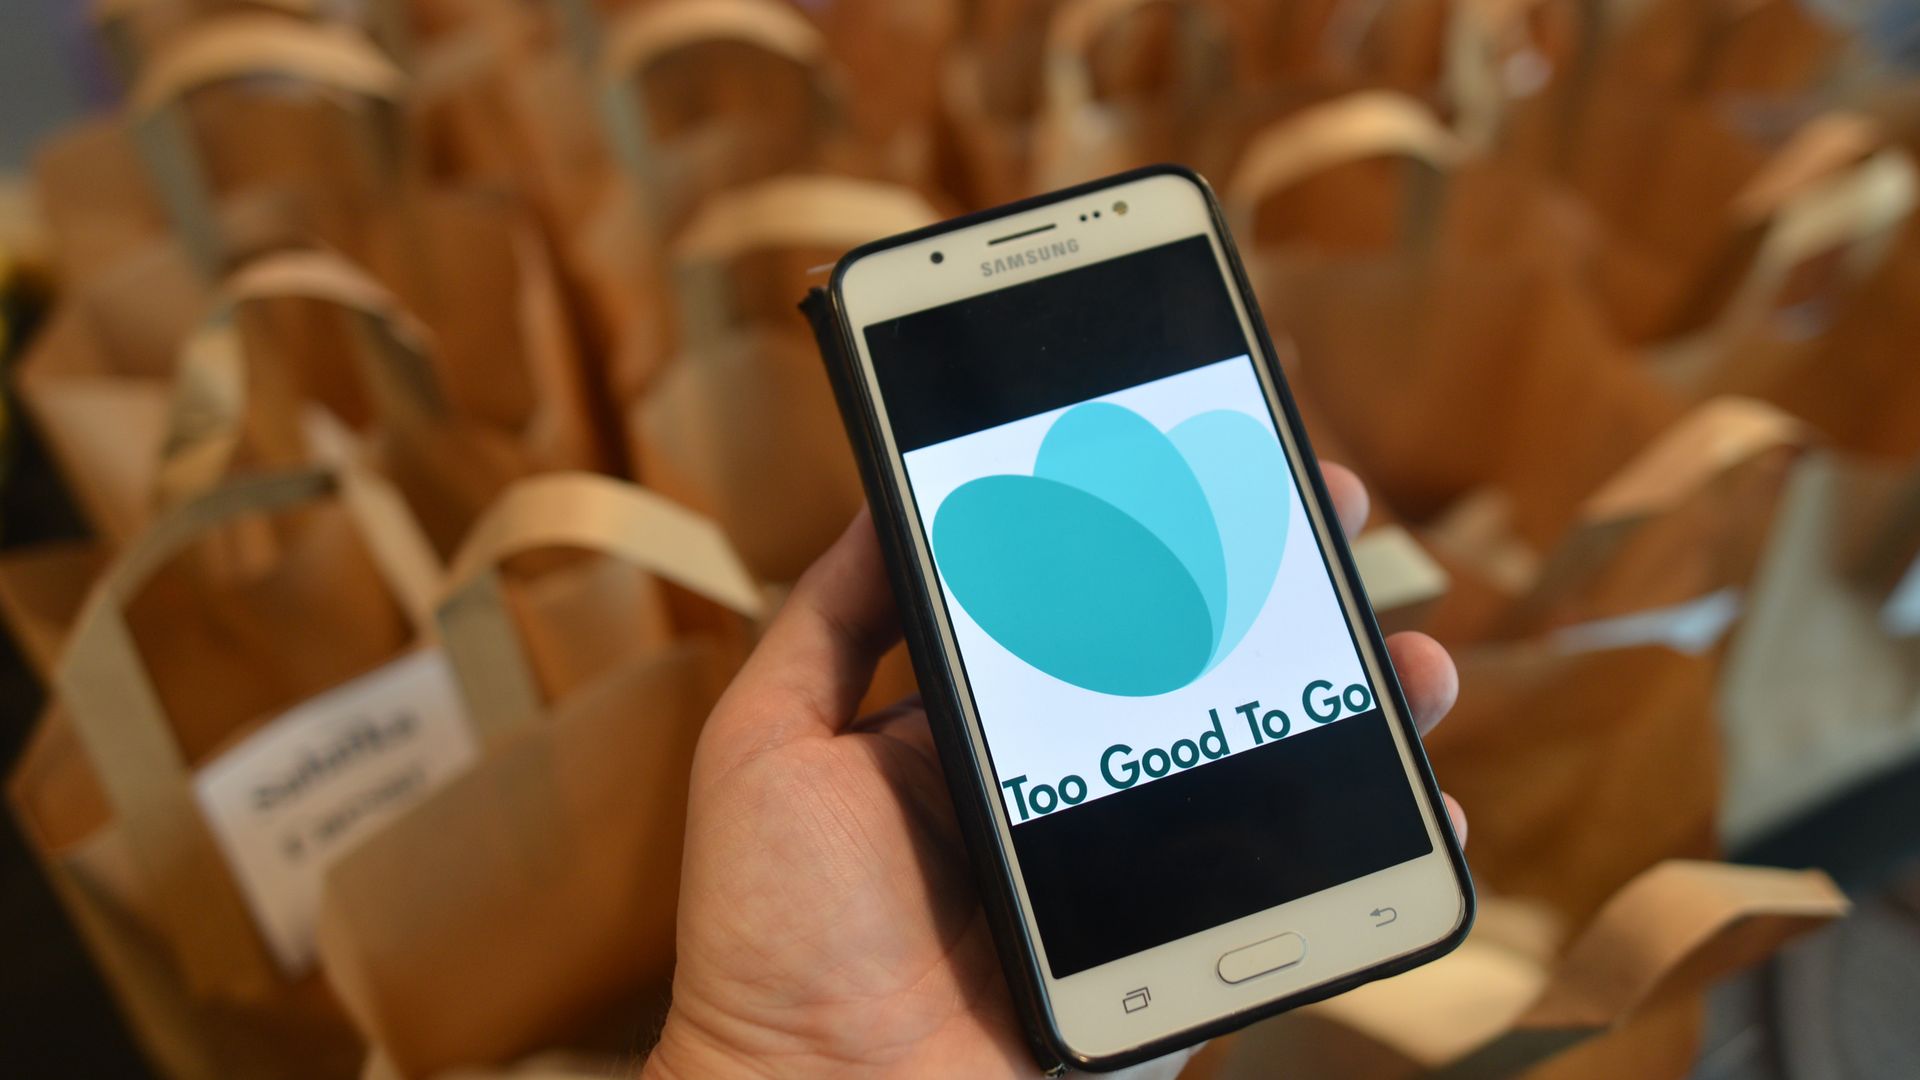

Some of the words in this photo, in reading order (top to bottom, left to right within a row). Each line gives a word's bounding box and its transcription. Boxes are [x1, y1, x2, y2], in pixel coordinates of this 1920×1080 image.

[980, 239, 1080, 277] SAMSUNG
[1002, 774, 1088, 821] Too
[1100, 708, 1231, 790] Good
[1235, 700, 1291, 745] To
[1301, 679, 1372, 724] Go
